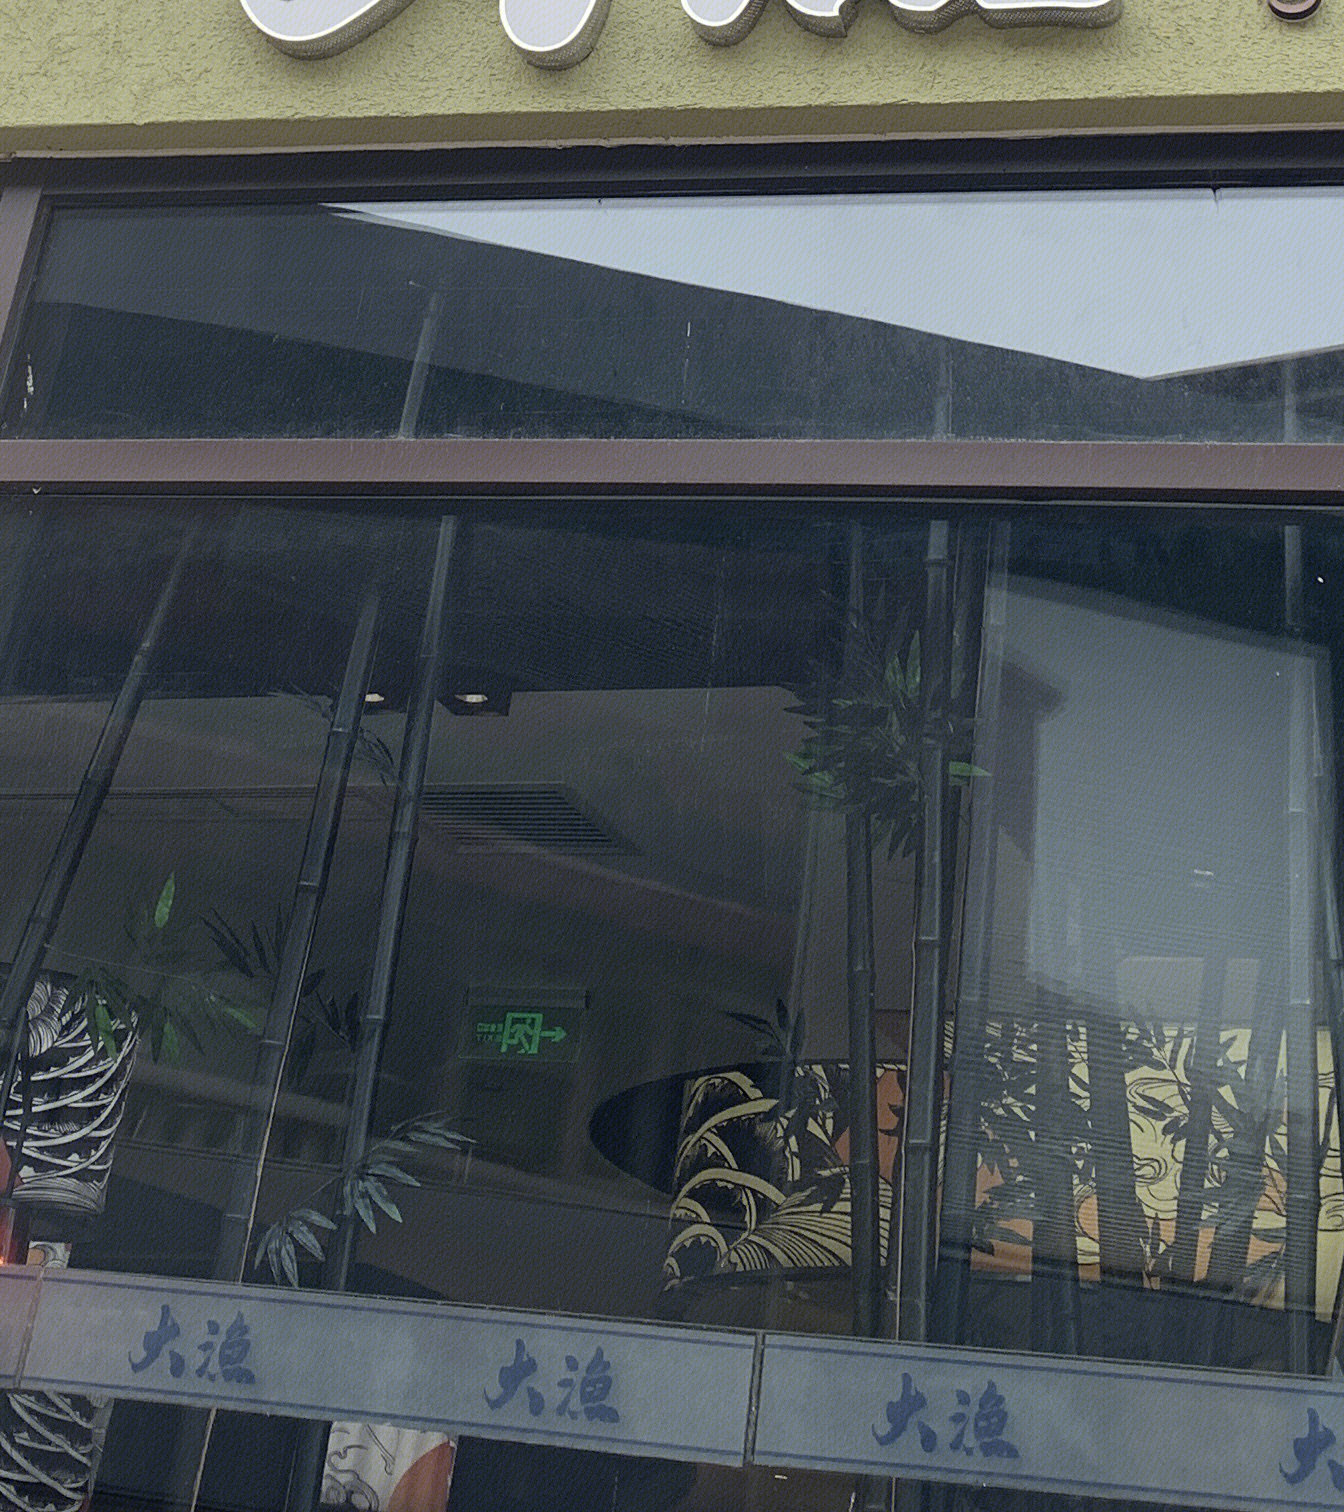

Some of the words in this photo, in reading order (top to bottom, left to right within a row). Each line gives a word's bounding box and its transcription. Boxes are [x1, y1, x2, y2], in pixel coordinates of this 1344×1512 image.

[130, 1304, 262, 1387] 大渔
[484, 1339, 620, 1424] 大渔
[873, 1373, 1020, 1461] 大渔
